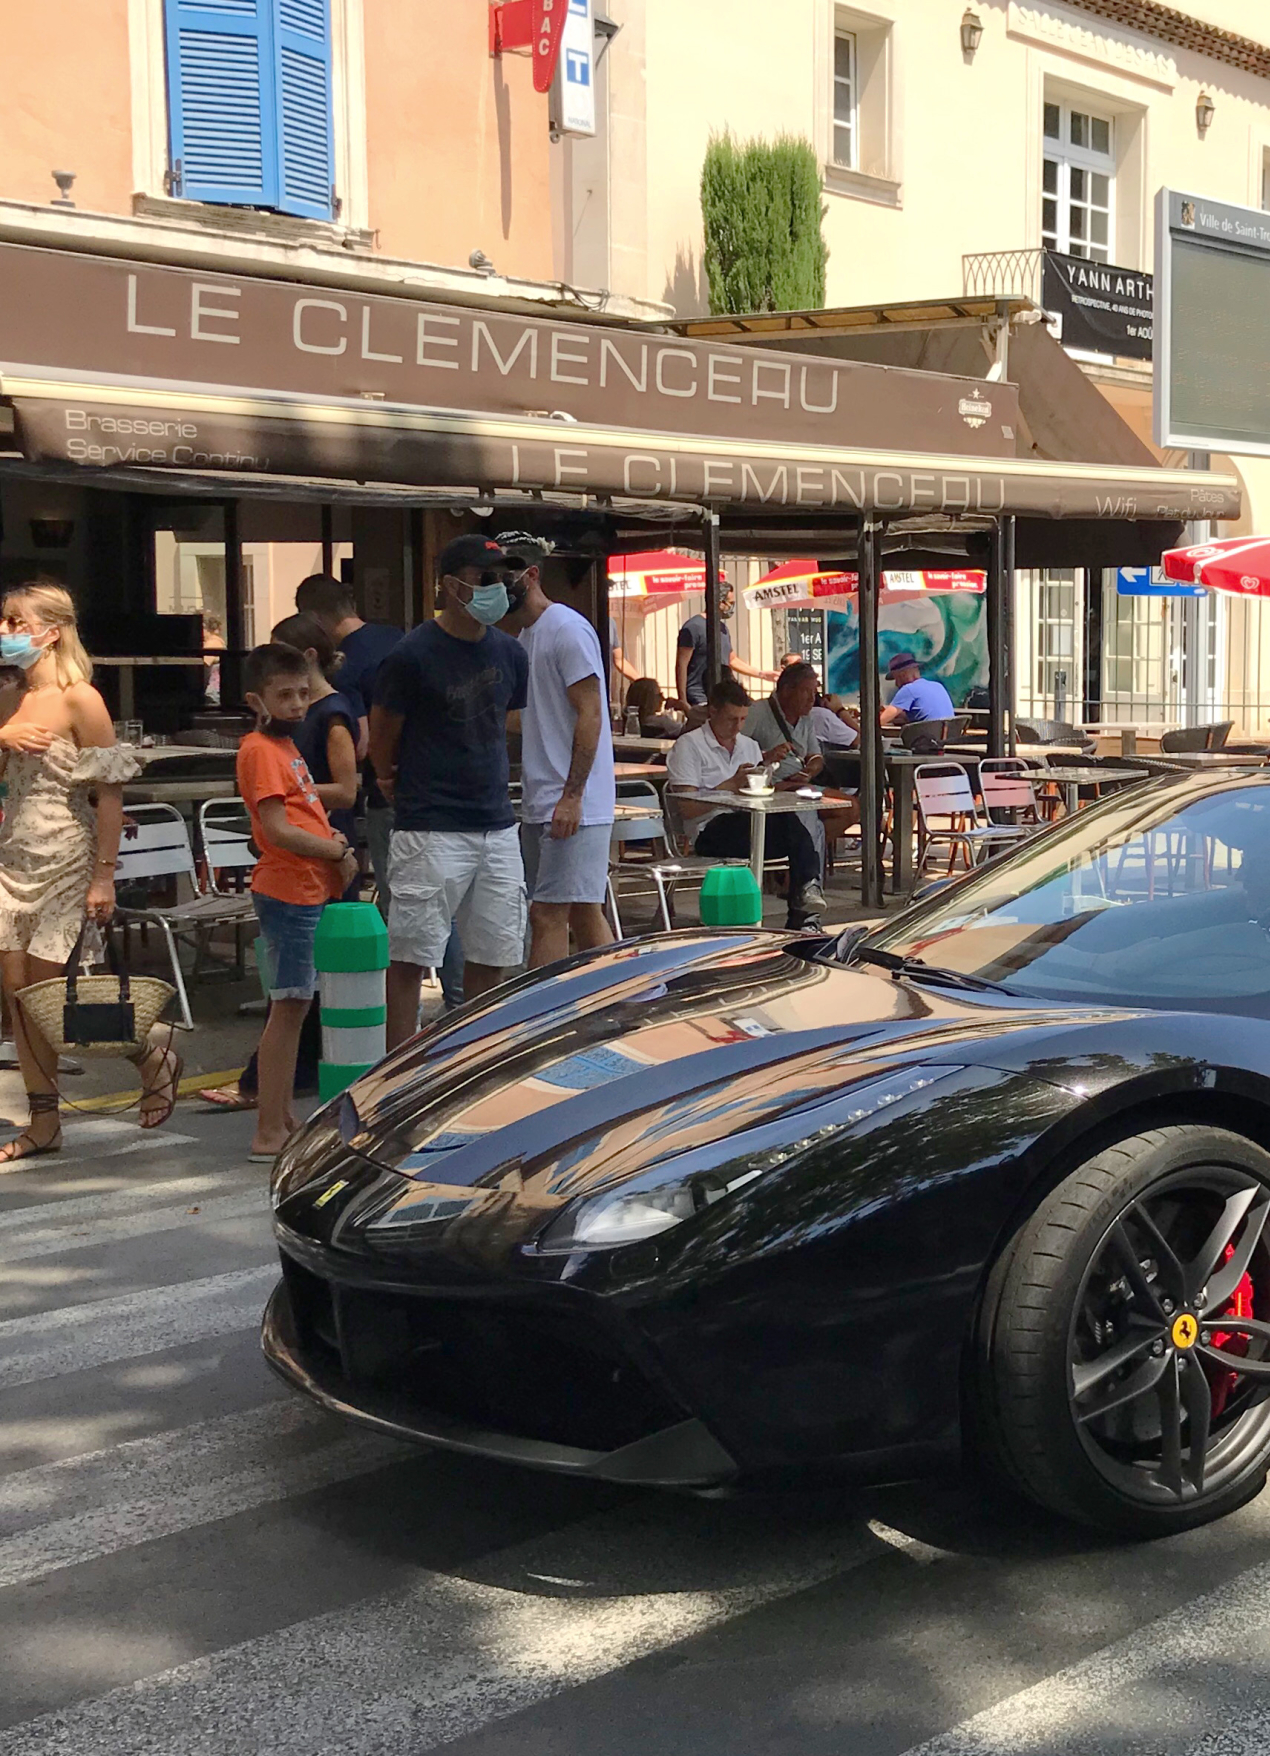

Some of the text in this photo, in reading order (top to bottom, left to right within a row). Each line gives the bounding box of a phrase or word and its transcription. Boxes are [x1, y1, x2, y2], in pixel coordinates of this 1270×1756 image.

[1200, 212, 1219, 231] Ville
[1221, 218, 1232, 233] de
[1067, 264, 1111, 292] YANN
[128, 274, 839, 414] LE CLEMENCEAU
[65, 408, 198, 439] Brasserie
[66, 438, 270, 471] Service Continu
[512, 445, 1004, 513] LE CLEMENCEAU
[1096, 495, 1137, 519] Wifi
[1191, 488, 1225, 504] Pâtes
[890, 572, 914, 583] AMSTEL
[754, 583, 800, 602] AMSTEL
